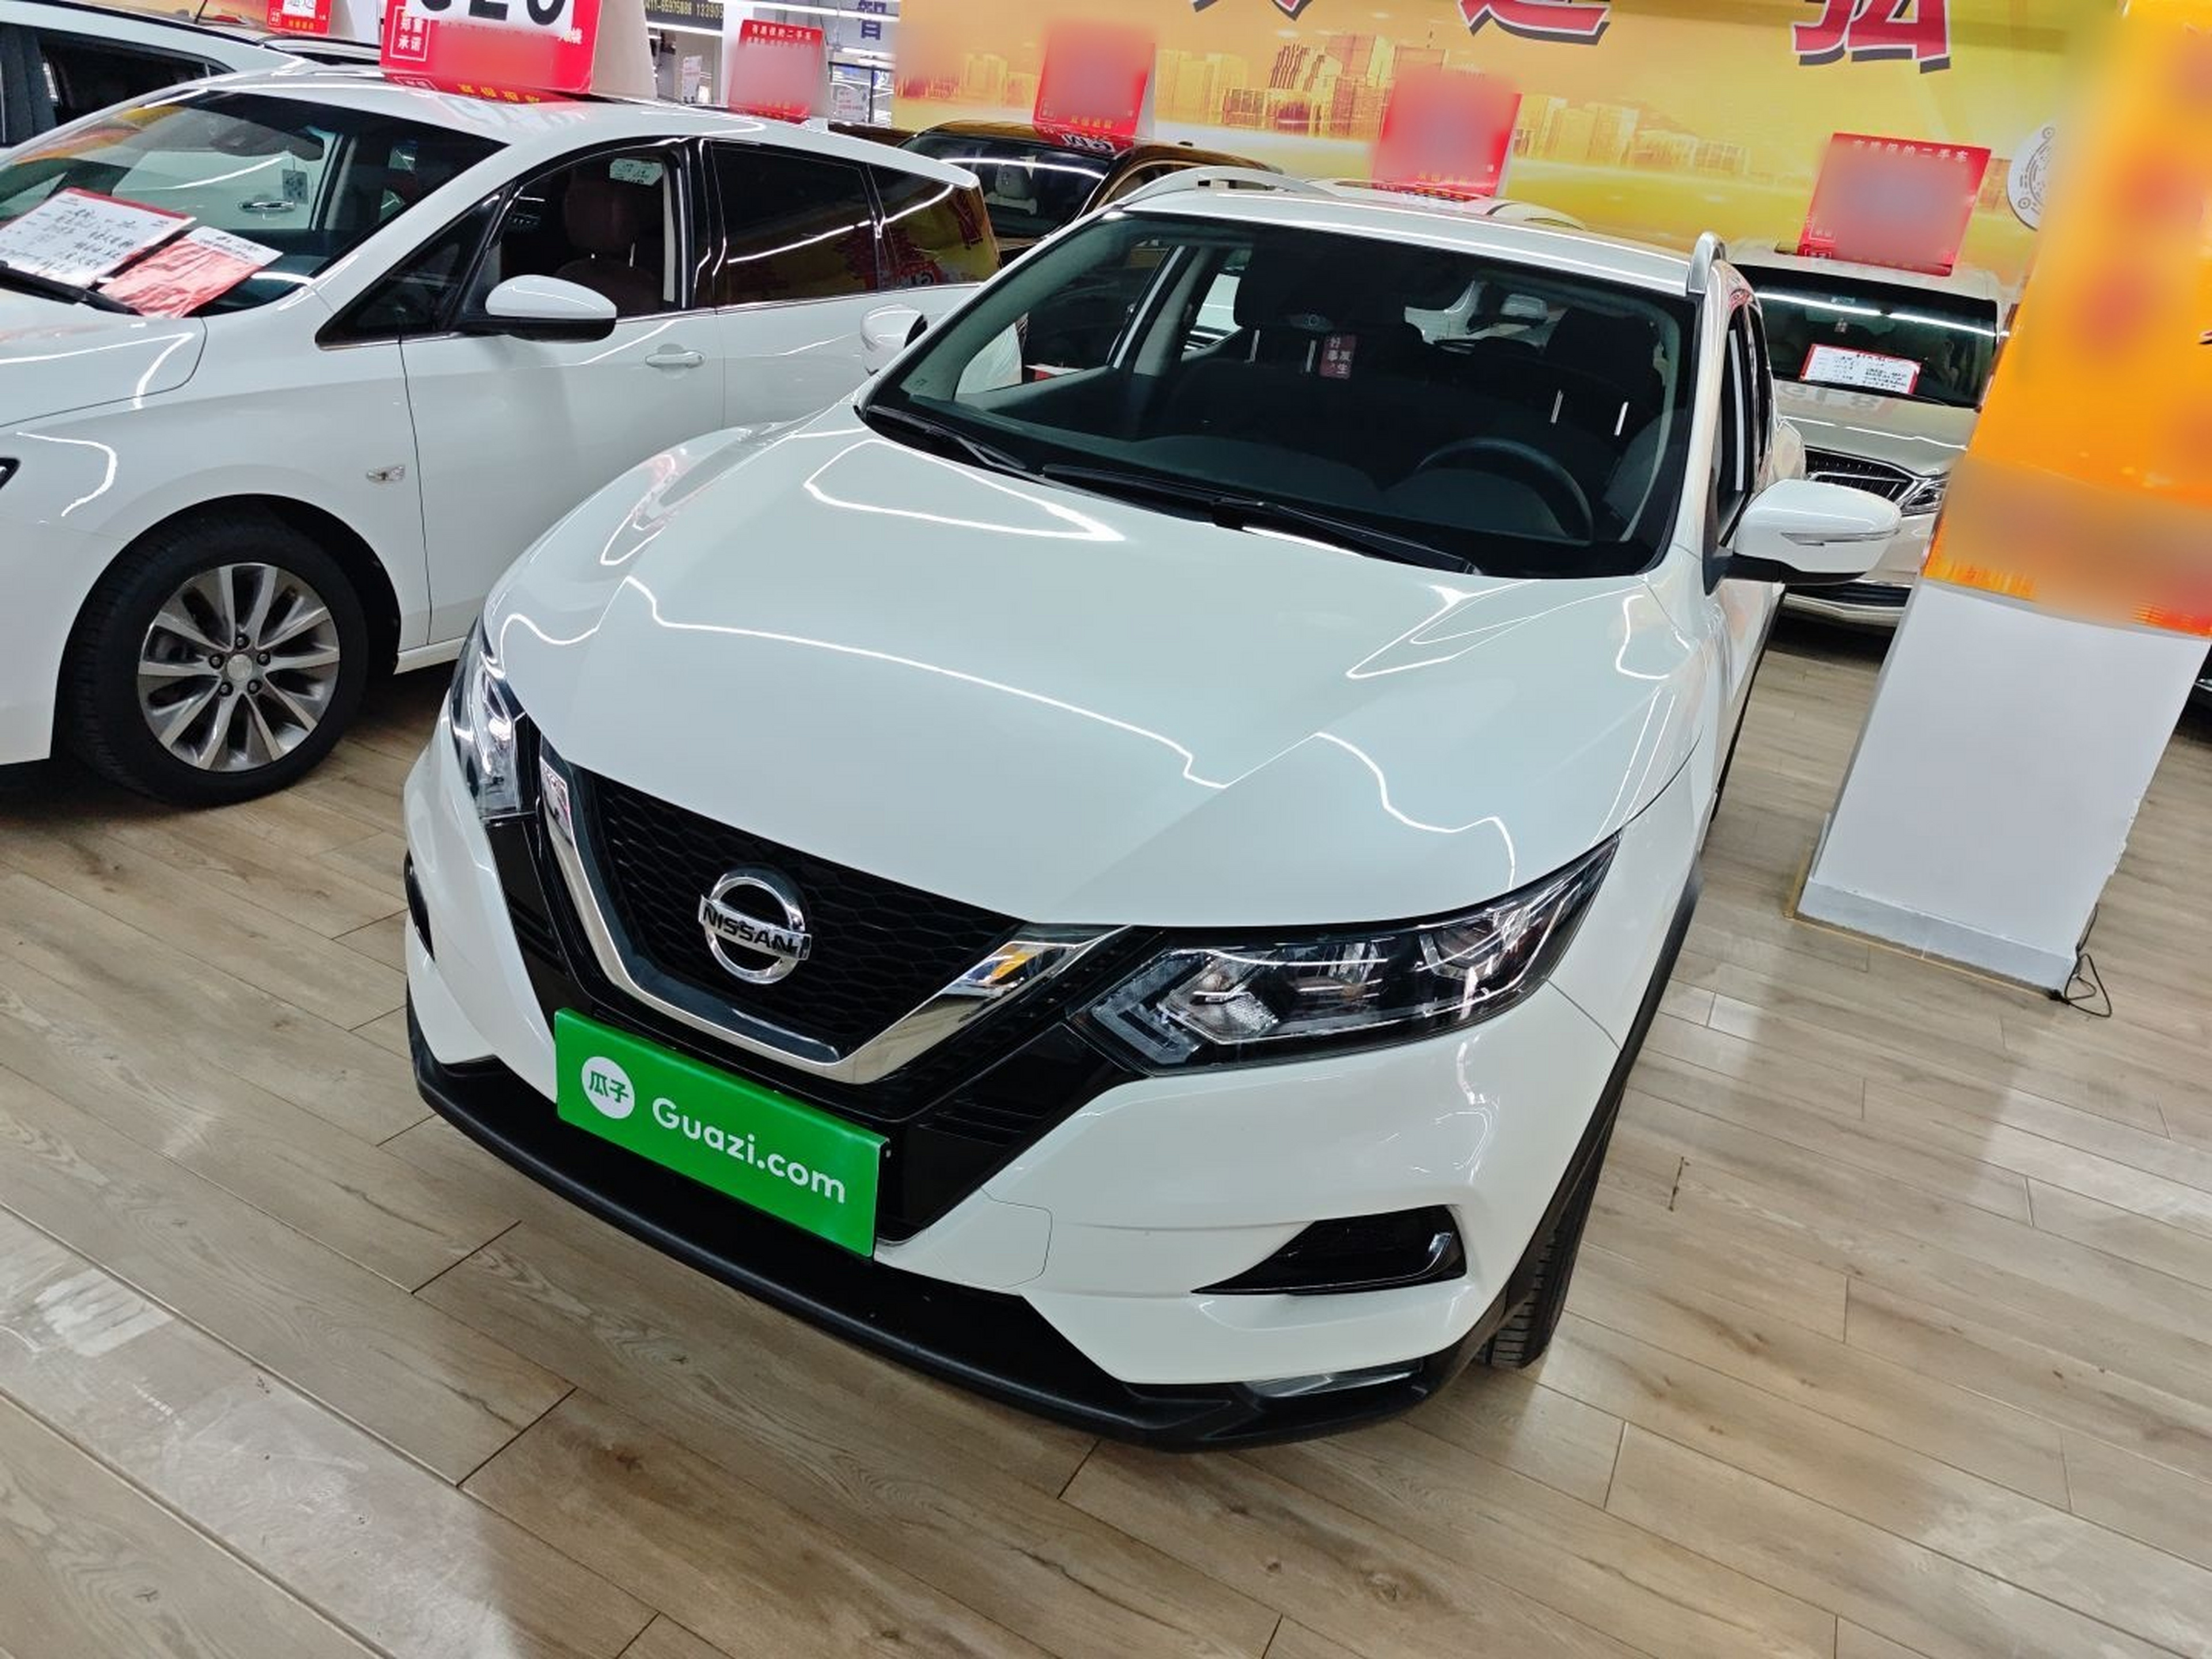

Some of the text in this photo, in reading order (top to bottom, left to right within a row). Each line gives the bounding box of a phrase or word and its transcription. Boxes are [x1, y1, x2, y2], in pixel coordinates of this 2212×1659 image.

[397, 35, 422, 52] 承诺
[703, 902, 799, 955] NISSAN
[589, 1071, 630, 1103] 瓜子
[652, 1097, 846, 1204] Guazi.com
